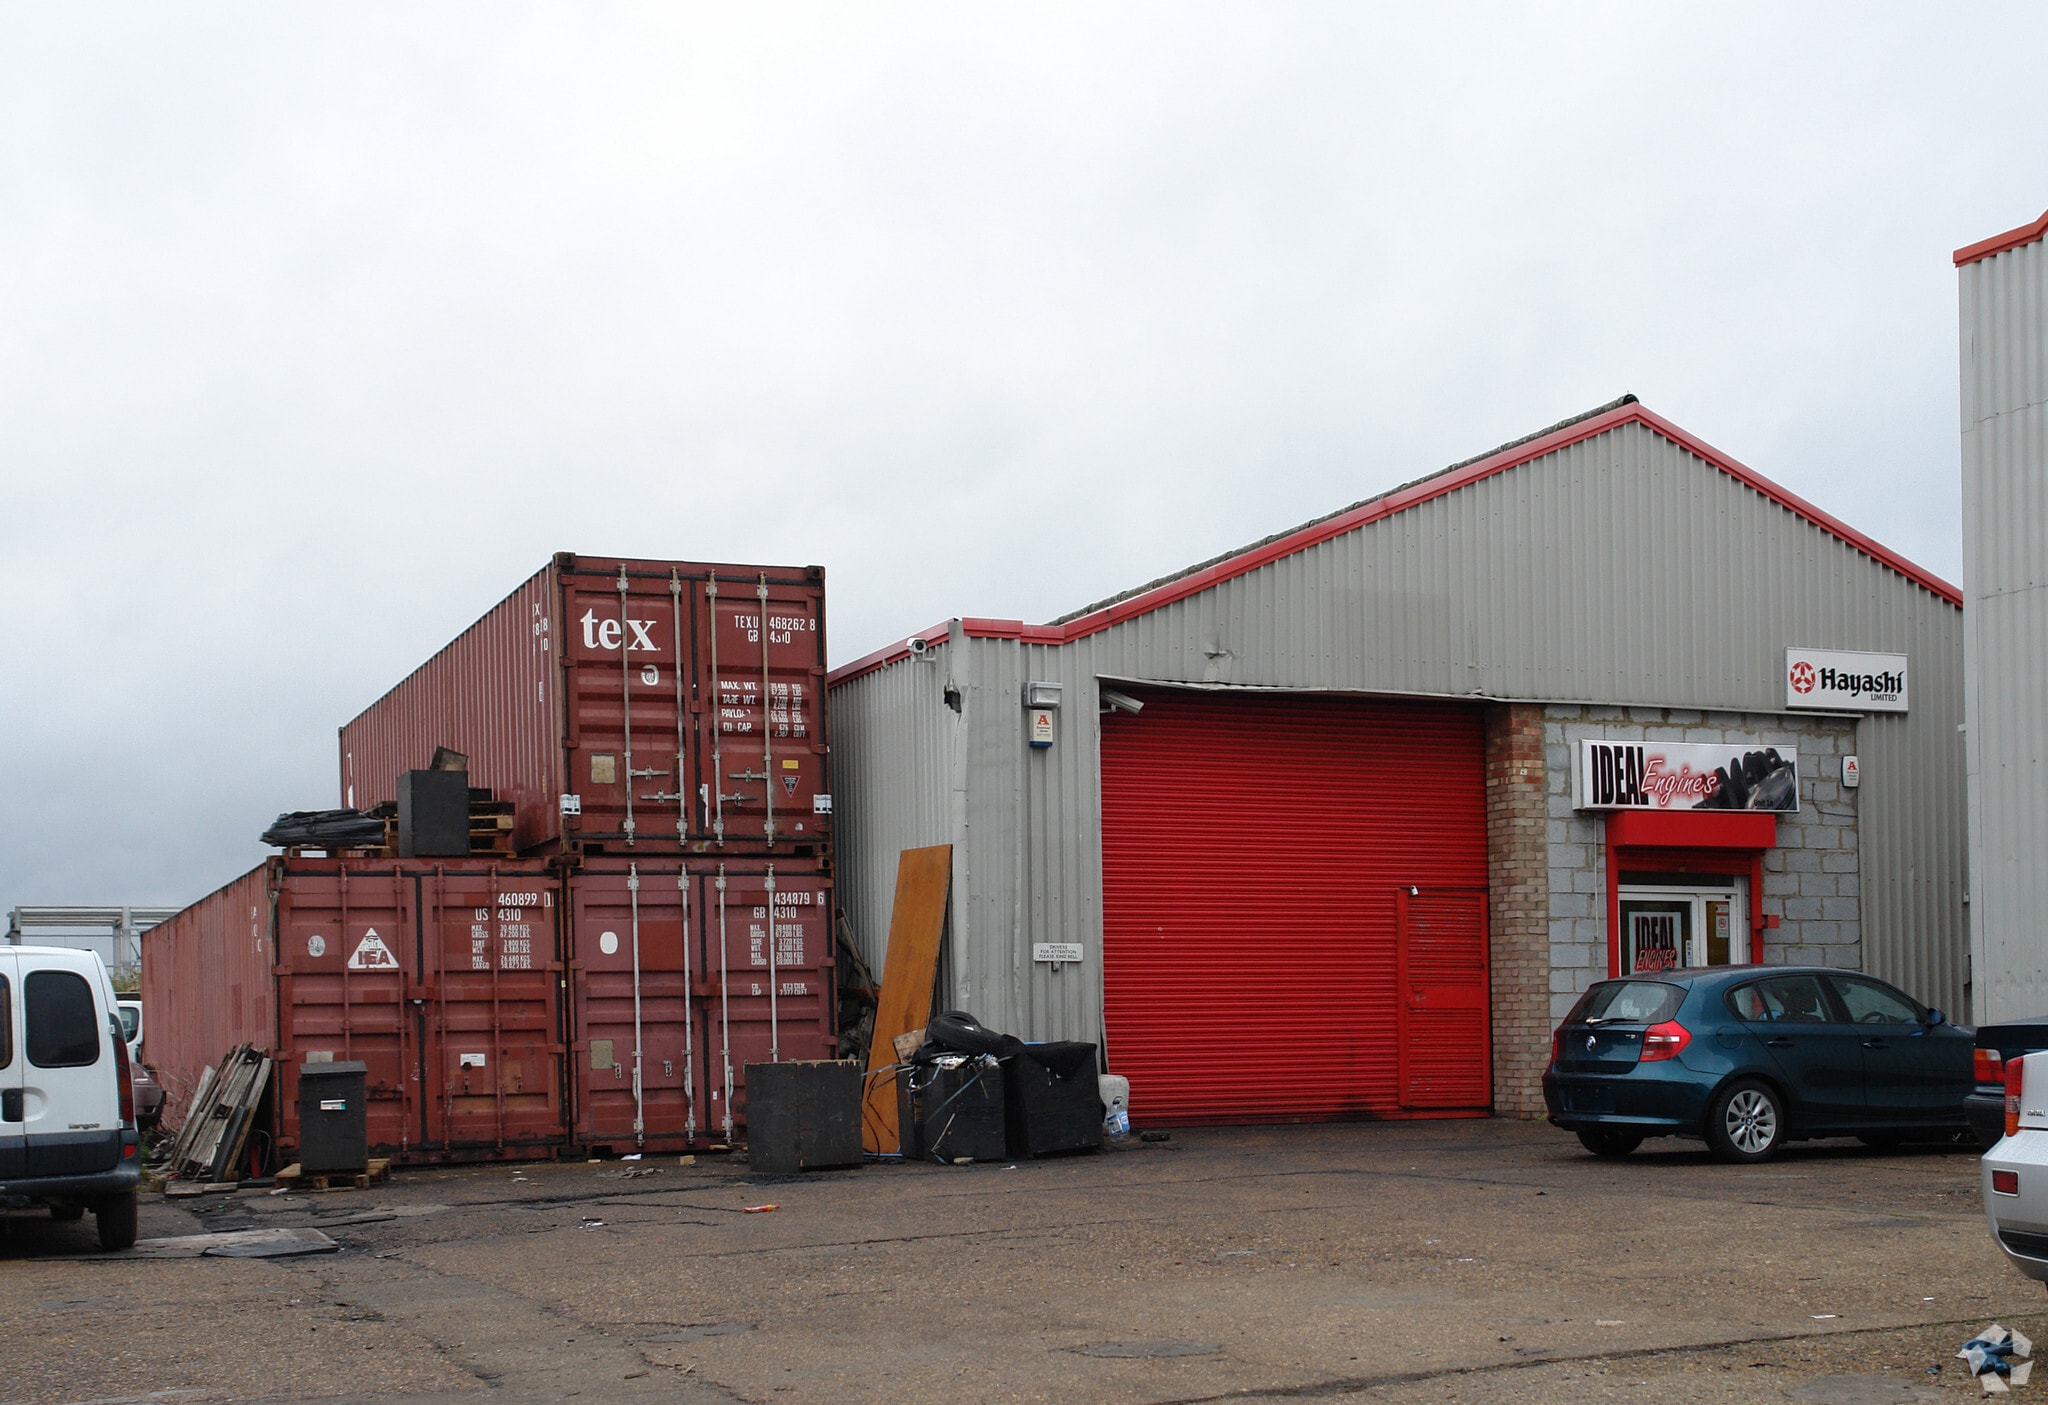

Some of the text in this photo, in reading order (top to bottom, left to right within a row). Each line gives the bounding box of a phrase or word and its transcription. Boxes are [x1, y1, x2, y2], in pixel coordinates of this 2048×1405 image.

[580, 607, 659, 651] tex
[734, 615, 816, 631] TEXU 468262 8
[747, 629, 759, 642] GB
[1818, 667, 1905, 697] Hayashi
[1871, 694, 1898, 702] LIMITED
[1037, 714, 1050, 725] A
[1847, 761, 1858, 771] A
[1591, 744, 1718, 805] IDEAL Engines
[498, 892, 538, 906] 460899
[774, 892, 825, 905] 434879 6
[475, 908, 521, 921] US 4310
[753, 906, 797, 919] GB 4310
[1635, 916, 1675, 954] IDEAL
